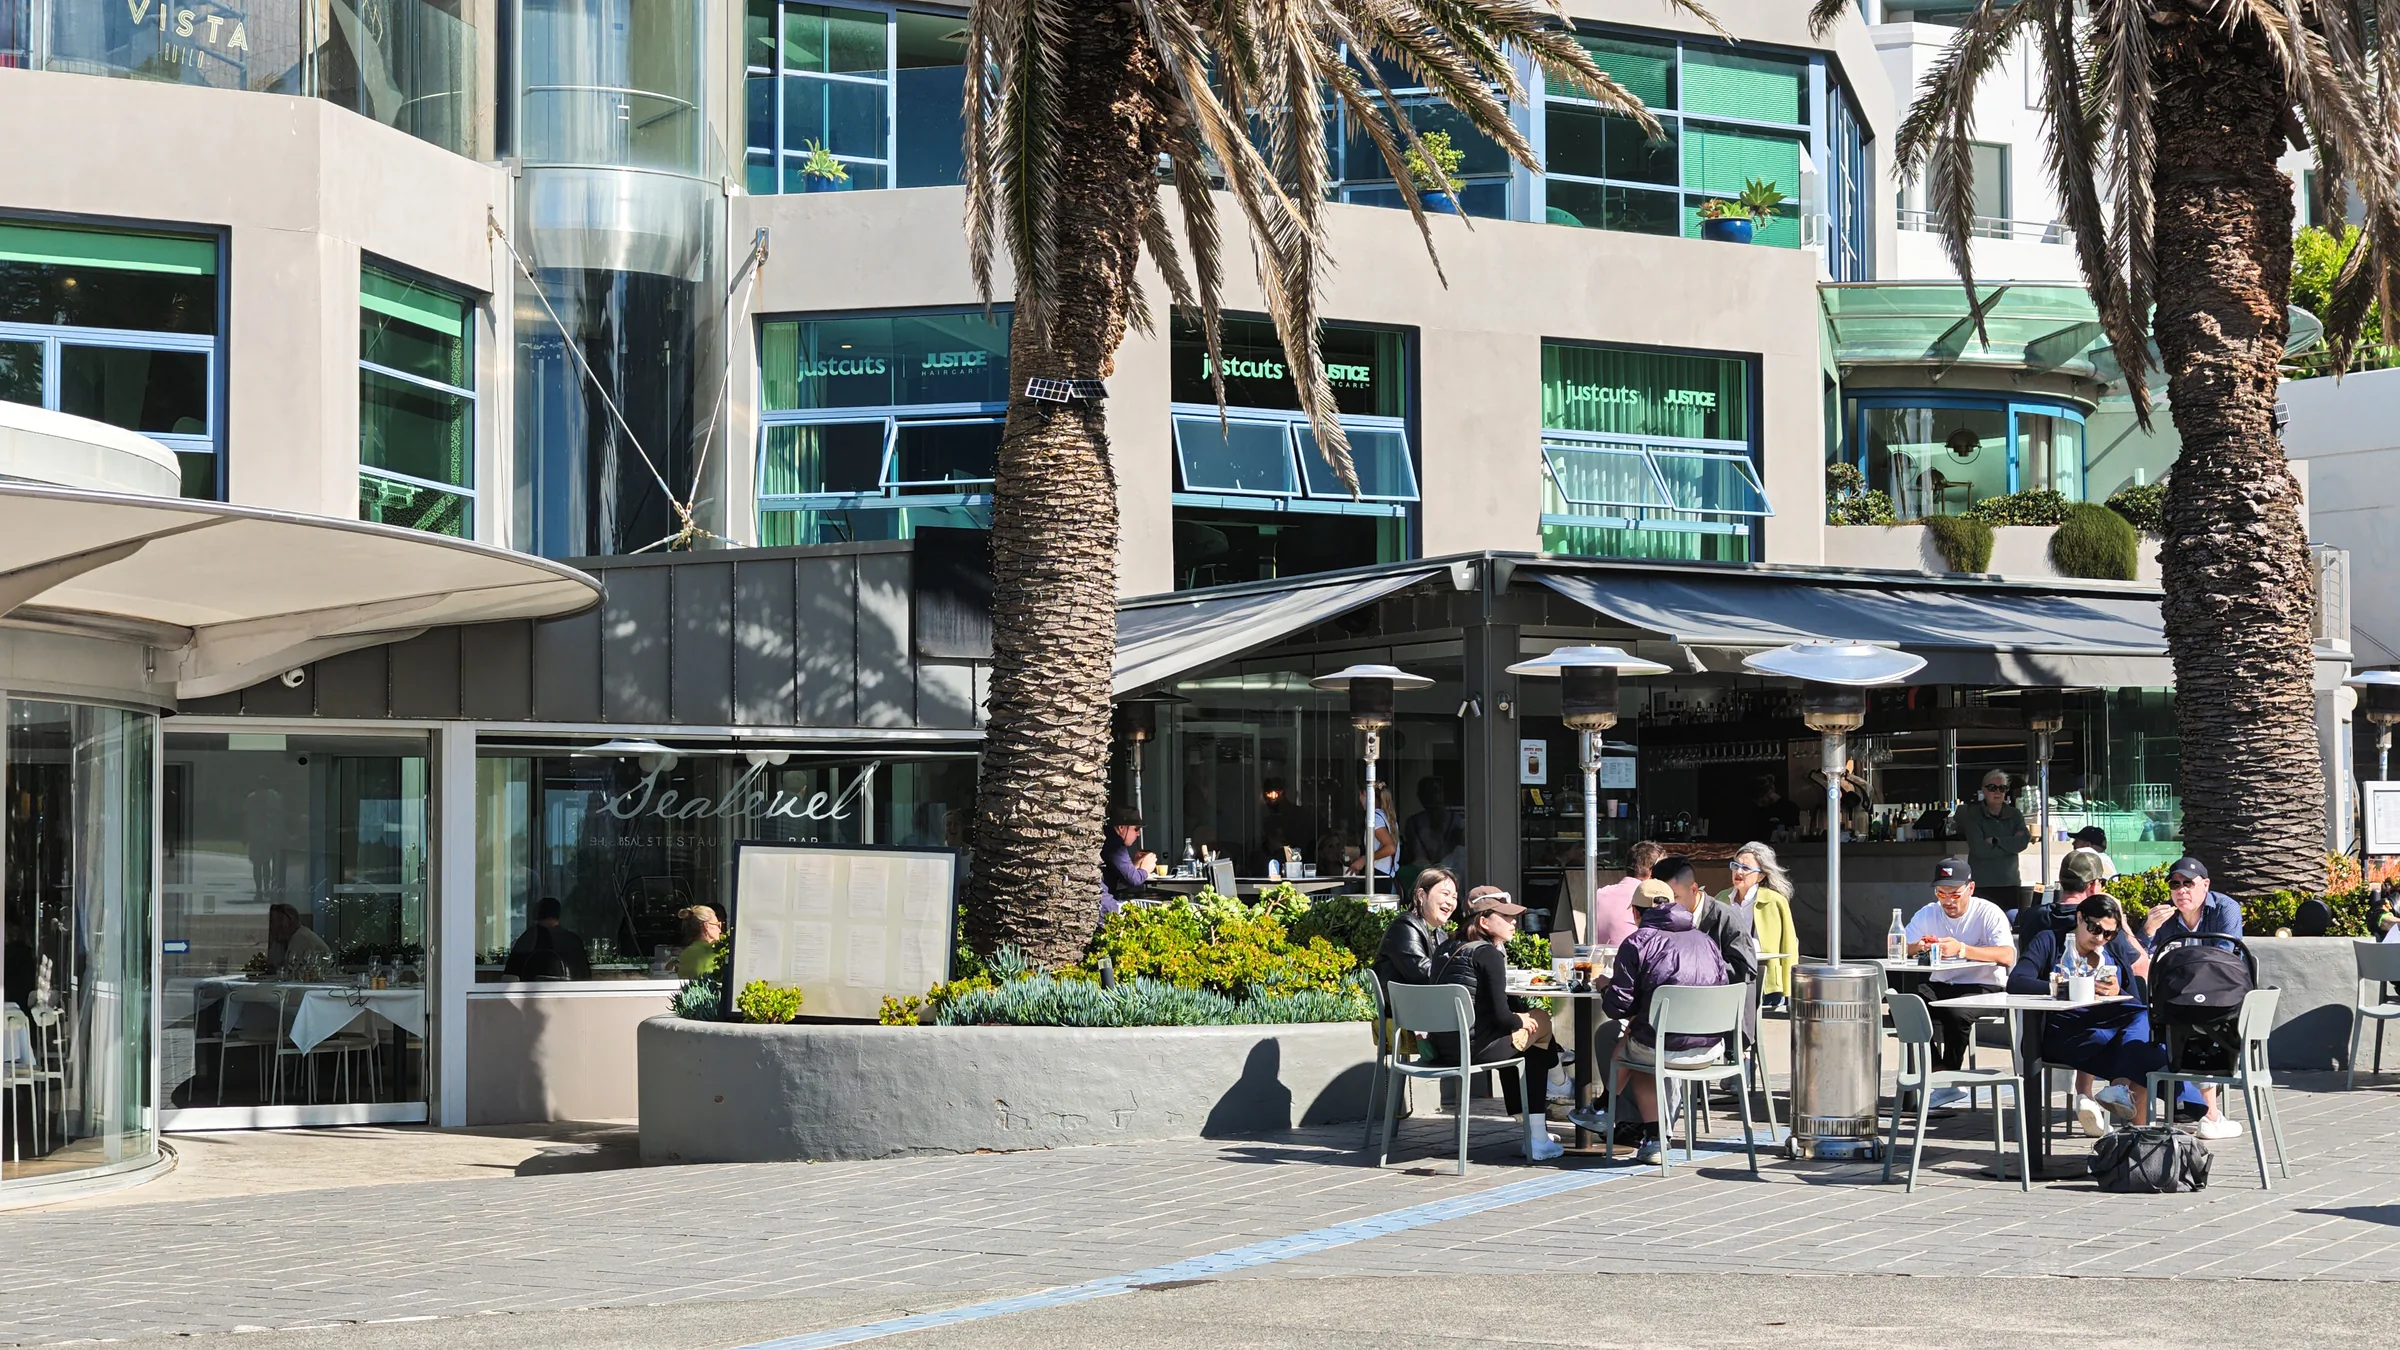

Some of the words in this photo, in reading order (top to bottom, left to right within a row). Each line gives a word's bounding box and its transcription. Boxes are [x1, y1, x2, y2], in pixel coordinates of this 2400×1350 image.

[127, 0, 248, 51] VISTA
[797, 355, 886, 382] justcuts
[921, 351, 987, 369] JUSTICE
[1202, 353, 1284, 380] jstcuts
[1322, 363, 1370, 382] USTICE
[1565, 379, 1639, 405] justcuts
[1663, 389, 1716, 407] JUSTICE
